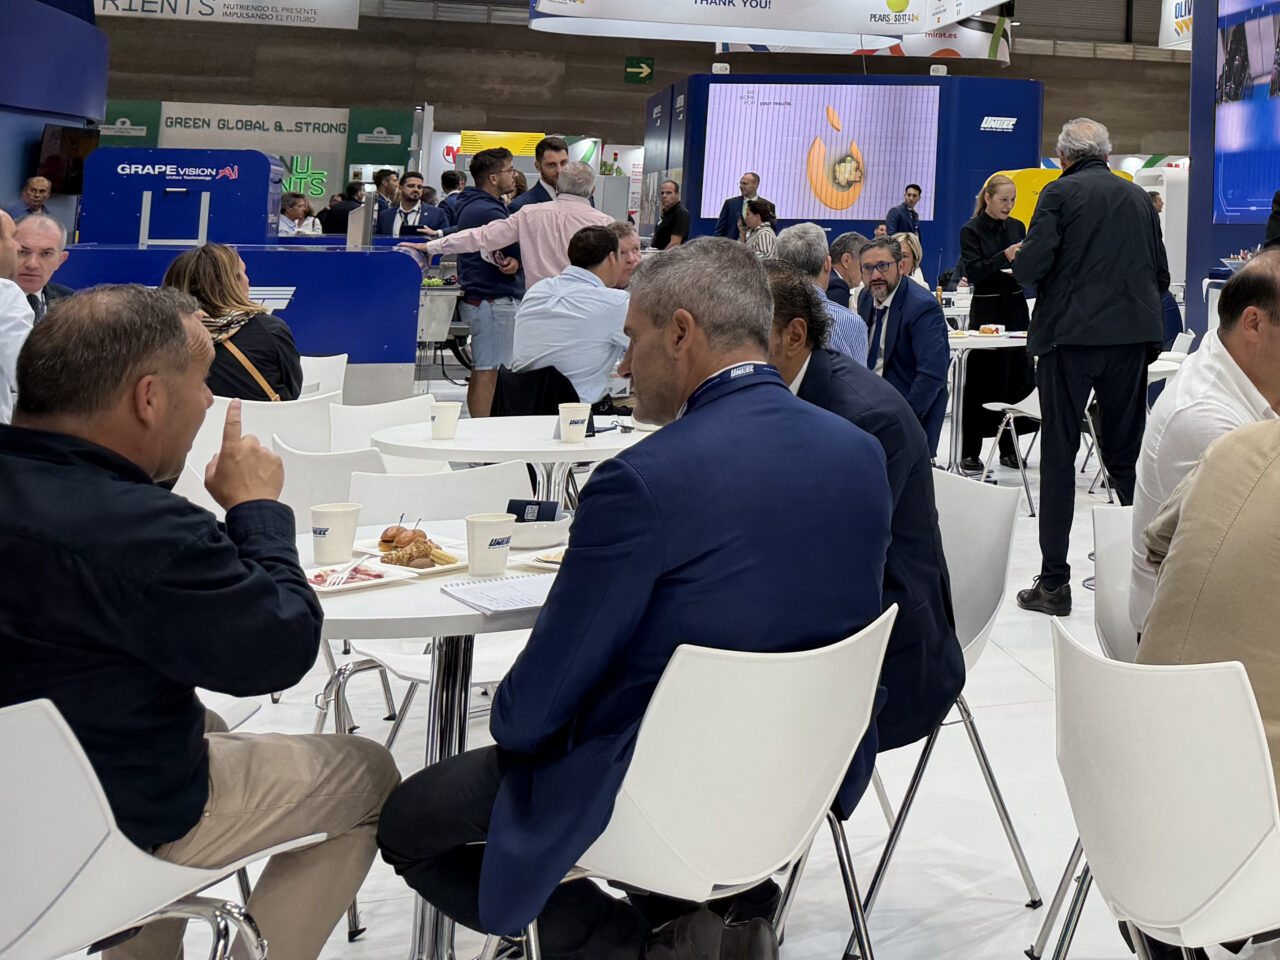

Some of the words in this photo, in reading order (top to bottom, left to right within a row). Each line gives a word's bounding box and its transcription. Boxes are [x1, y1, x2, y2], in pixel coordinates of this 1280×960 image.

[223, 3, 269, 12] NUTRIENDO
[281, 7, 318, 15] PRESENTE
[222, 12, 273, 20] IMPULSANDO
[286, 15, 316, 23] FUTURO
[869, 13, 891, 22] PEARS
[894, 13, 907, 22] SORT
[925, 31, 958, 39] mirat.es
[165, 116, 211, 129] GREEN
[217, 118, 270, 131] GLOBAL
[980, 116, 1018, 129] UNITEC
[117, 164, 178, 175] GRAPE
[178, 167, 216, 176] VISION
